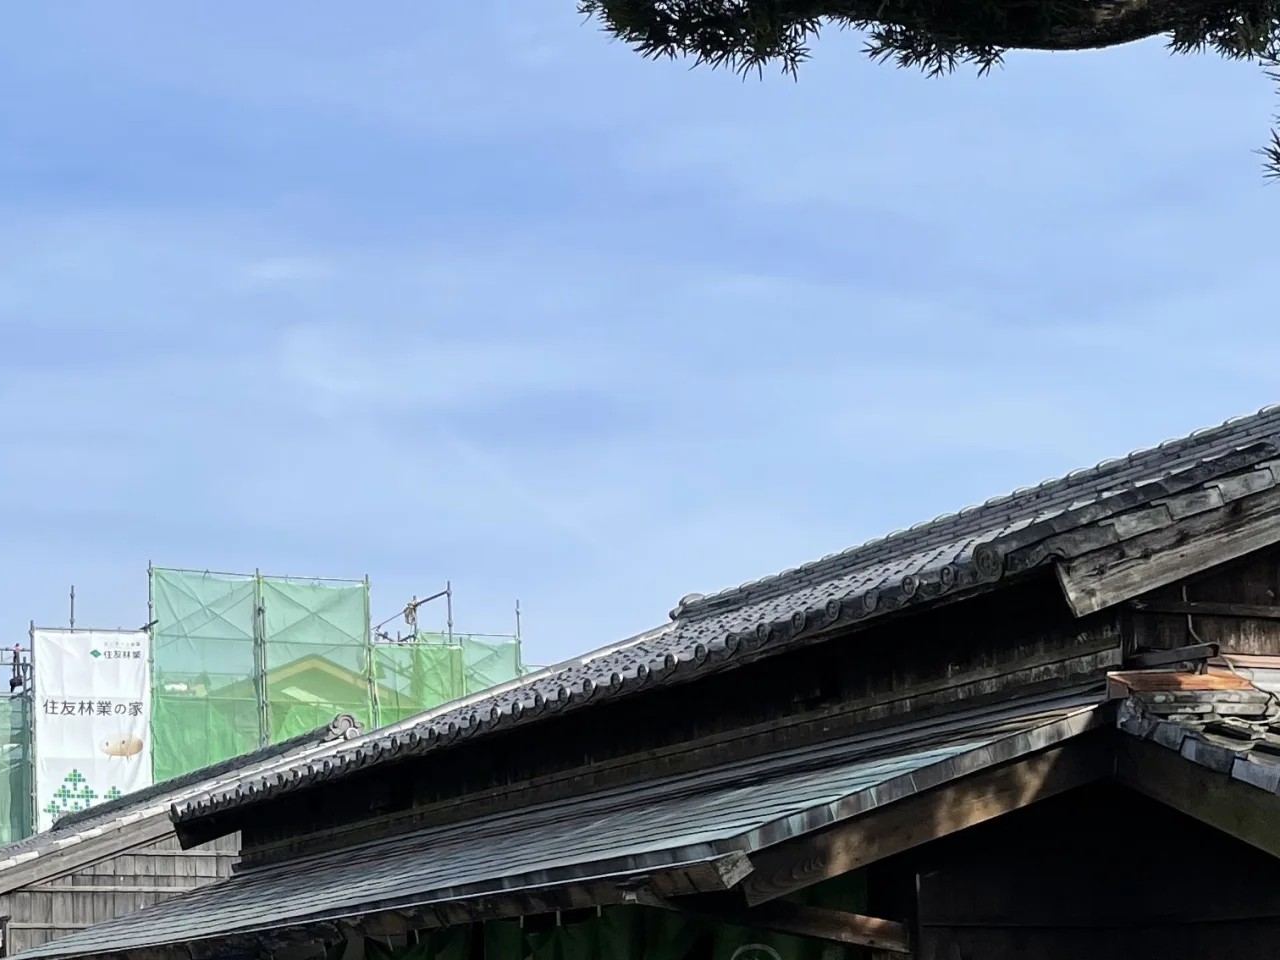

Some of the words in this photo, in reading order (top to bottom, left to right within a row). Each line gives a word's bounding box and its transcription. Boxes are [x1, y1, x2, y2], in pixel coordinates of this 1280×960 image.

[103, 650, 141, 659] 住友林業
[42, 698, 144, 717] 住友林業の家
